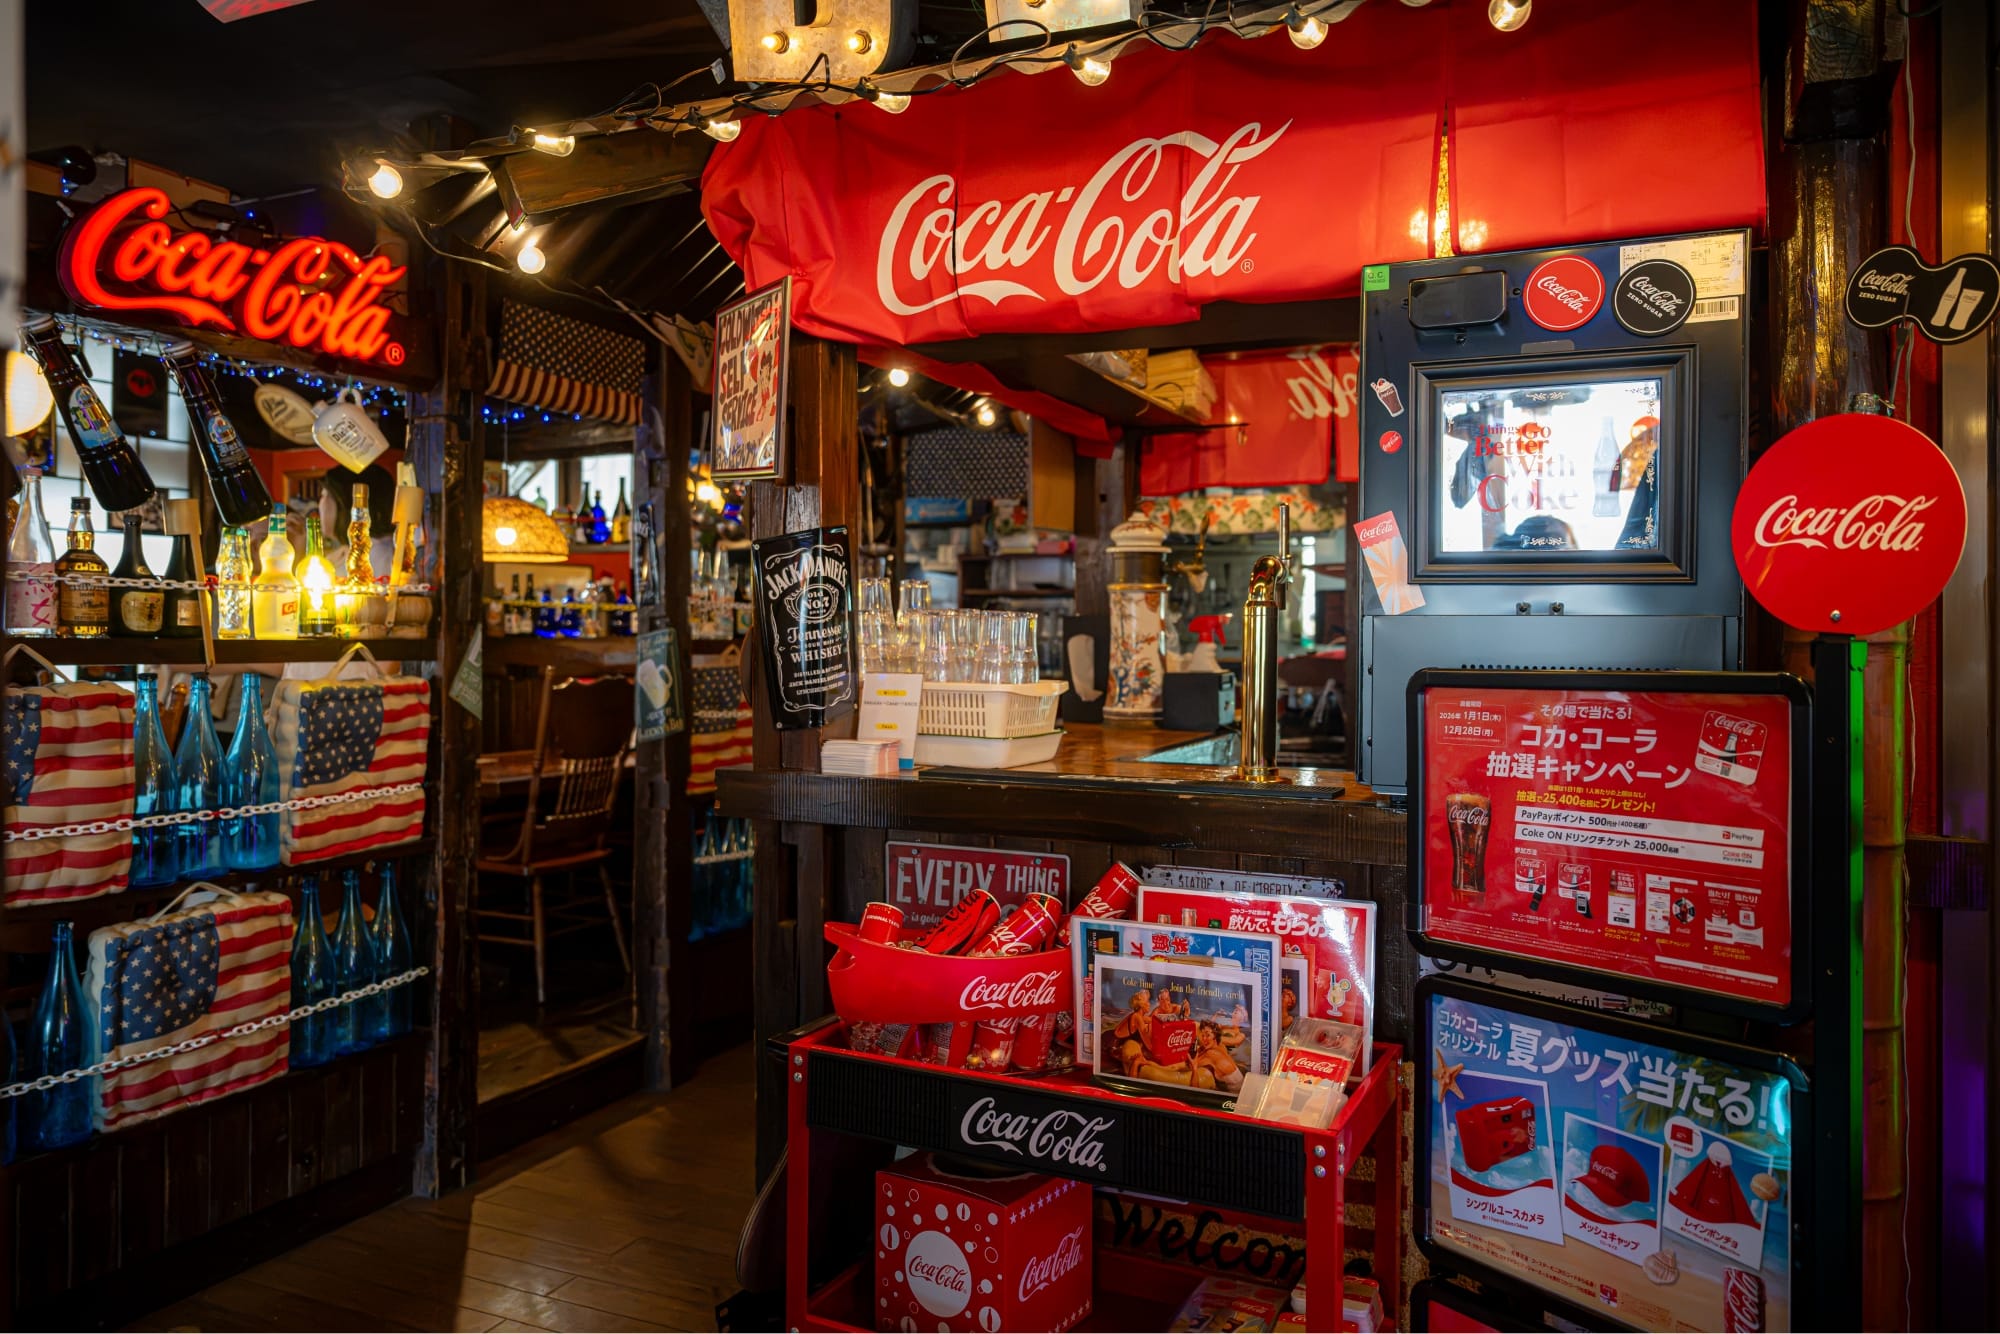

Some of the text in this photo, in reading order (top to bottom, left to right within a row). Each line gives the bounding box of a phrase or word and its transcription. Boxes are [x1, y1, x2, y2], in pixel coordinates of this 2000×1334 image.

[876, 118, 1294, 316] Coca-Cola
[70, 187, 407, 362] Coca-Cola
[1859, 269, 1916, 295] Coca-Cola
[1537, 276, 1591, 312] Coca-Cola
[1626, 292, 1663, 319] ZERO SUGAR
[1629, 276, 1685, 314] Coca-Cola
[1858, 291, 1897, 303] ZERO SUGAR
[1479, 422, 1552, 439] Things Go
[1474, 436, 1550, 458] Better
[1505, 453, 1575, 479] With
[1477, 474, 1579, 513] Coke
[1359, 520, 1394, 542] Coca-Cola
[1754, 494, 1939, 552] Coca-Cola
[765, 552, 849, 601] JACK DANIEL'S
[790, 643, 843, 664] WHISKEY
[1439, 711, 1461, 720] 2026年
[1540, 703, 1632, 720] その場で当たる!
[1714, 716, 1757, 736] Coca-Cola
[1521, 724, 1658, 754] コカ・コーラ
[1486, 750, 1691, 790] 抽選キャンペーン
[1449, 805, 1490, 827] Coca-Cola
[1516, 790, 1656, 813] 抽選で25,400名様にプレゼント!
[1521, 809, 1586, 826] PayPayポイント
[1521, 827, 1545, 838] Coke
[1547, 828, 1563, 840] ON
[1564, 833, 1631, 849] ドリンクチケット
[896, 856, 1060, 907] EVERY THING
[959, 970, 1062, 1011] Coca-Cola
[1122, 976, 1138, 988] Coke
[1169, 981, 1184, 993] Join
[1185, 984, 1197, 994] the
[1198, 985, 1224, 1000] friendly
[1439, 1009, 1504, 1040] コカ・コーラ
[1438, 1030, 1501, 1061] オリジナル
[1295, 1057, 1337, 1074] Coca-Cola
[1506, 1023, 1771, 1130] 夏グッズ当たる!
[960, 1096, 1116, 1170] Coca-Cola
[1465, 1197, 1545, 1226] シングルユースカメラ
[1579, 1220, 1640, 1251] メッシュキャップ
[909, 1255, 968, 1293] Coca-Cola
[1019, 1225, 1084, 1302] Coca-Cola
